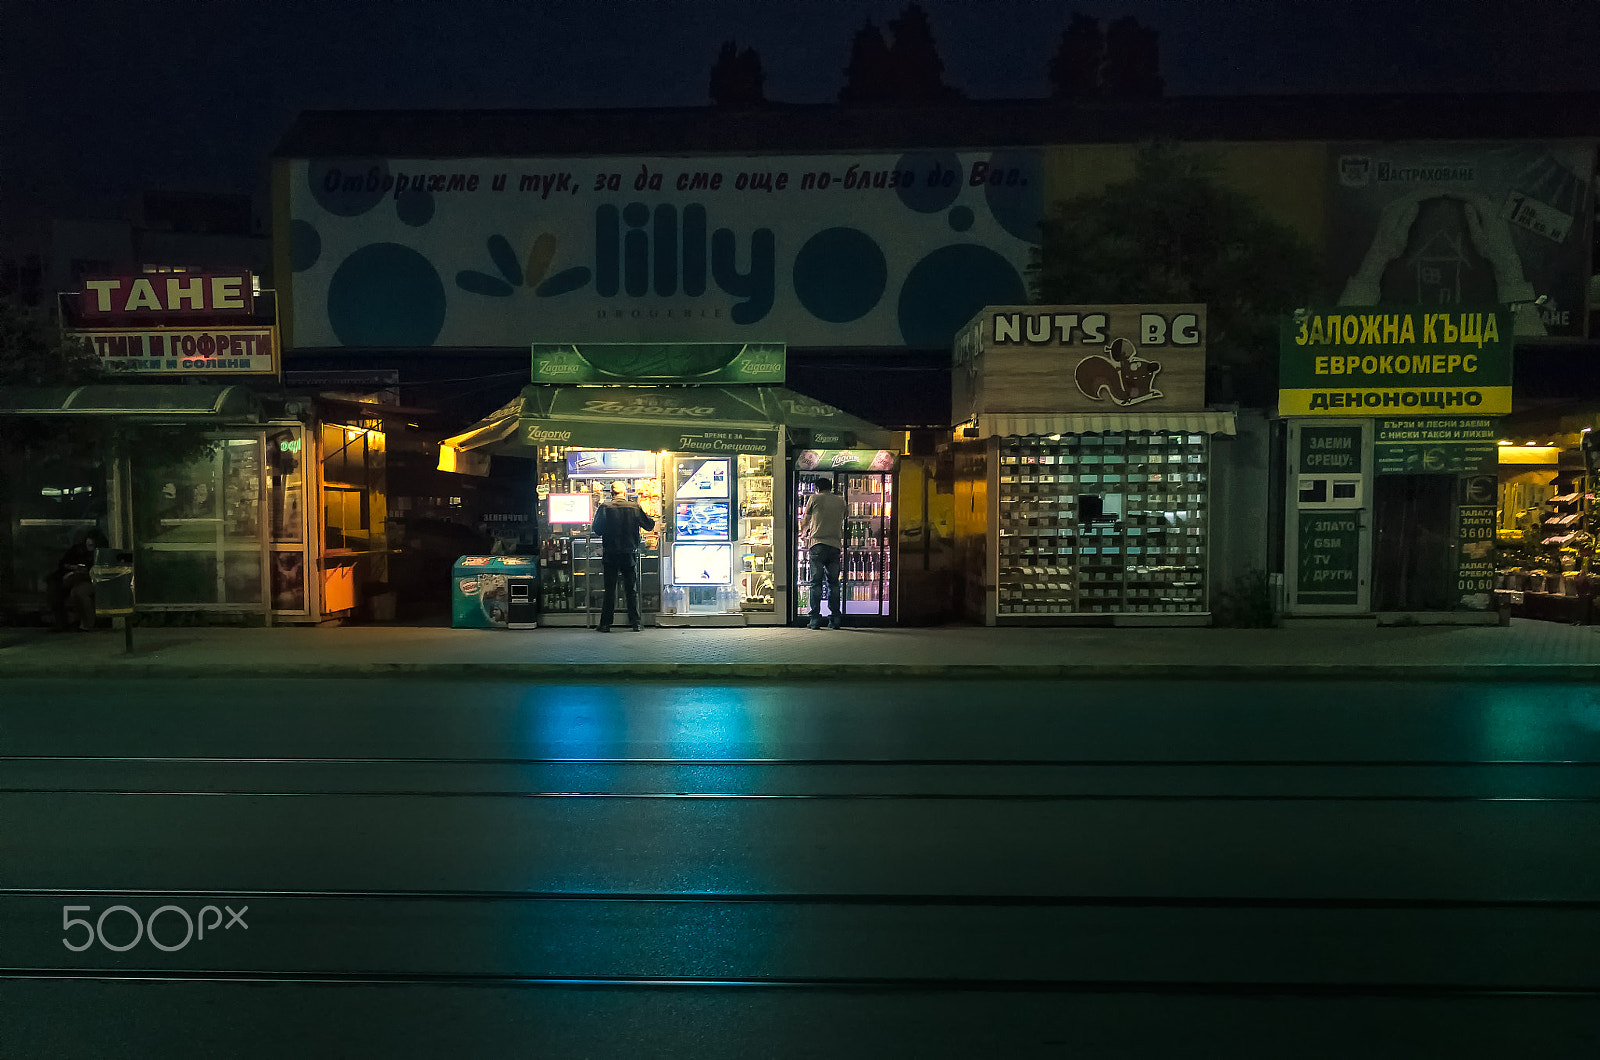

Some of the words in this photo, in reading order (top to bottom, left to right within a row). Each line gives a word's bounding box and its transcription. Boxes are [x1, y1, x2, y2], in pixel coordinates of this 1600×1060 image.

[324, 166, 480, 199] Отворихме
[491, 172, 507, 192] и
[519, 172, 580, 200] тук,
[593, 172, 621, 192] за
[633, 164, 663, 192] да
[676, 171, 723, 191] сме
[735, 171, 788, 192] още
[800, 164, 915, 190] по-близо
[927, 160, 956, 188] до
[595, 202, 775, 325] lilly
[86, 277, 245, 312] ТАНЕ
[994, 313, 1108, 344] NUTS
[1140, 313, 1200, 345] BG
[1295, 314, 1415, 346] ЗАЛОЖНА
[1423, 312, 1499, 348] КЪЩА
[170, 333, 271, 358] ГОФРЕТИ
[539, 360, 580, 374] Zagorka
[740, 359, 782, 373] Zagorka
[1314, 354, 1478, 375] ЕВРОКОМЕРС
[580, 400, 716, 416] Zagorka
[1309, 391, 1482, 411] ДЕНОНОЩНО
[1384, 421, 1415, 429] БЪРЗИ
[527, 425, 571, 442] Zagorka
[680, 437, 712, 451] Нещо
[713, 440, 767, 452] Специално
[1310, 437, 1351, 449] ЗАЕМИ
[1315, 521, 1355, 531] ЗЛАТО
[1460, 528, 1492, 538] 3600
[1314, 538, 1341, 548] GSM
[1314, 555, 1331, 565] TV
[1313, 570, 1352, 581] ДРУГИ
